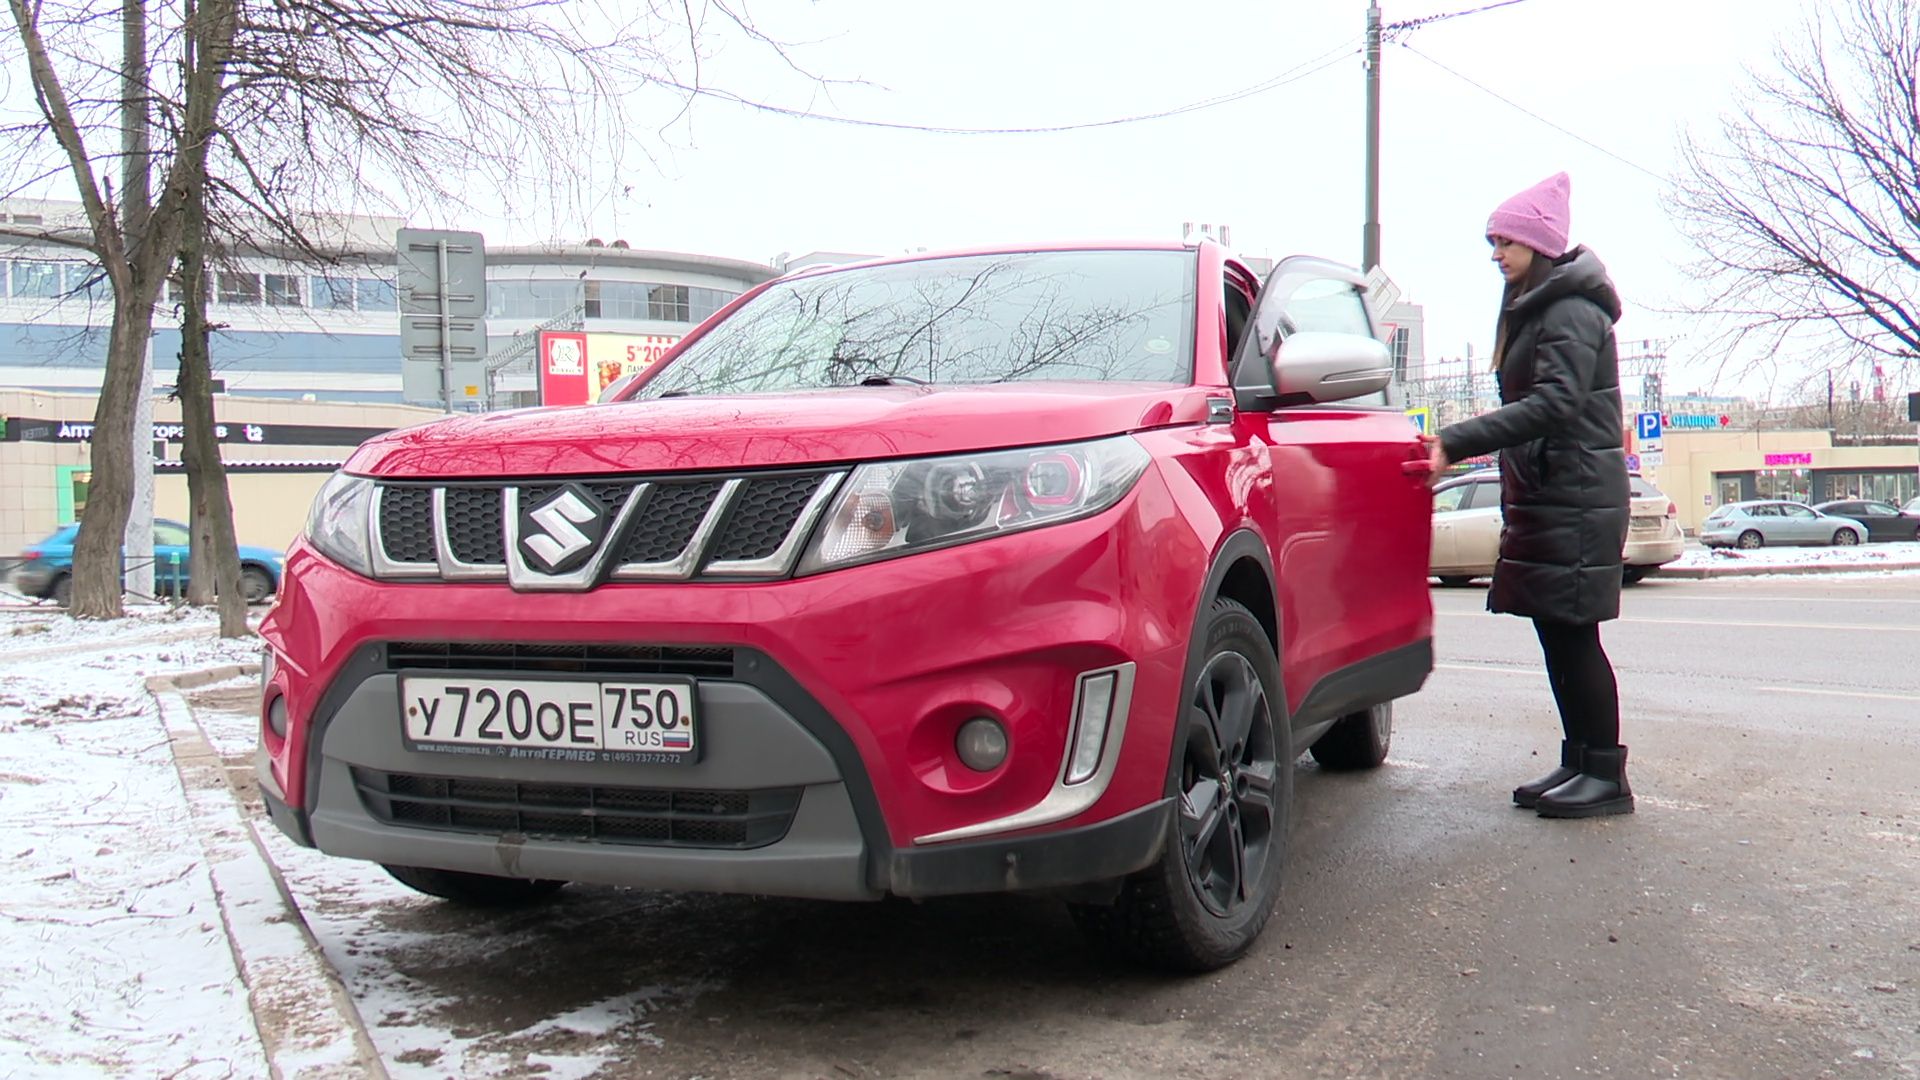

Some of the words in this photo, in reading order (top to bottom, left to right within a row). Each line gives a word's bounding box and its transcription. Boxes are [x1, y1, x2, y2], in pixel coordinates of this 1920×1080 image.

[644, 346, 671, 362] 20
[58, 425, 95, 438] АПТ
[1643, 415, 1657, 437] P
[605, 687, 679, 730] 750
[624, 730, 661, 746] RUS
